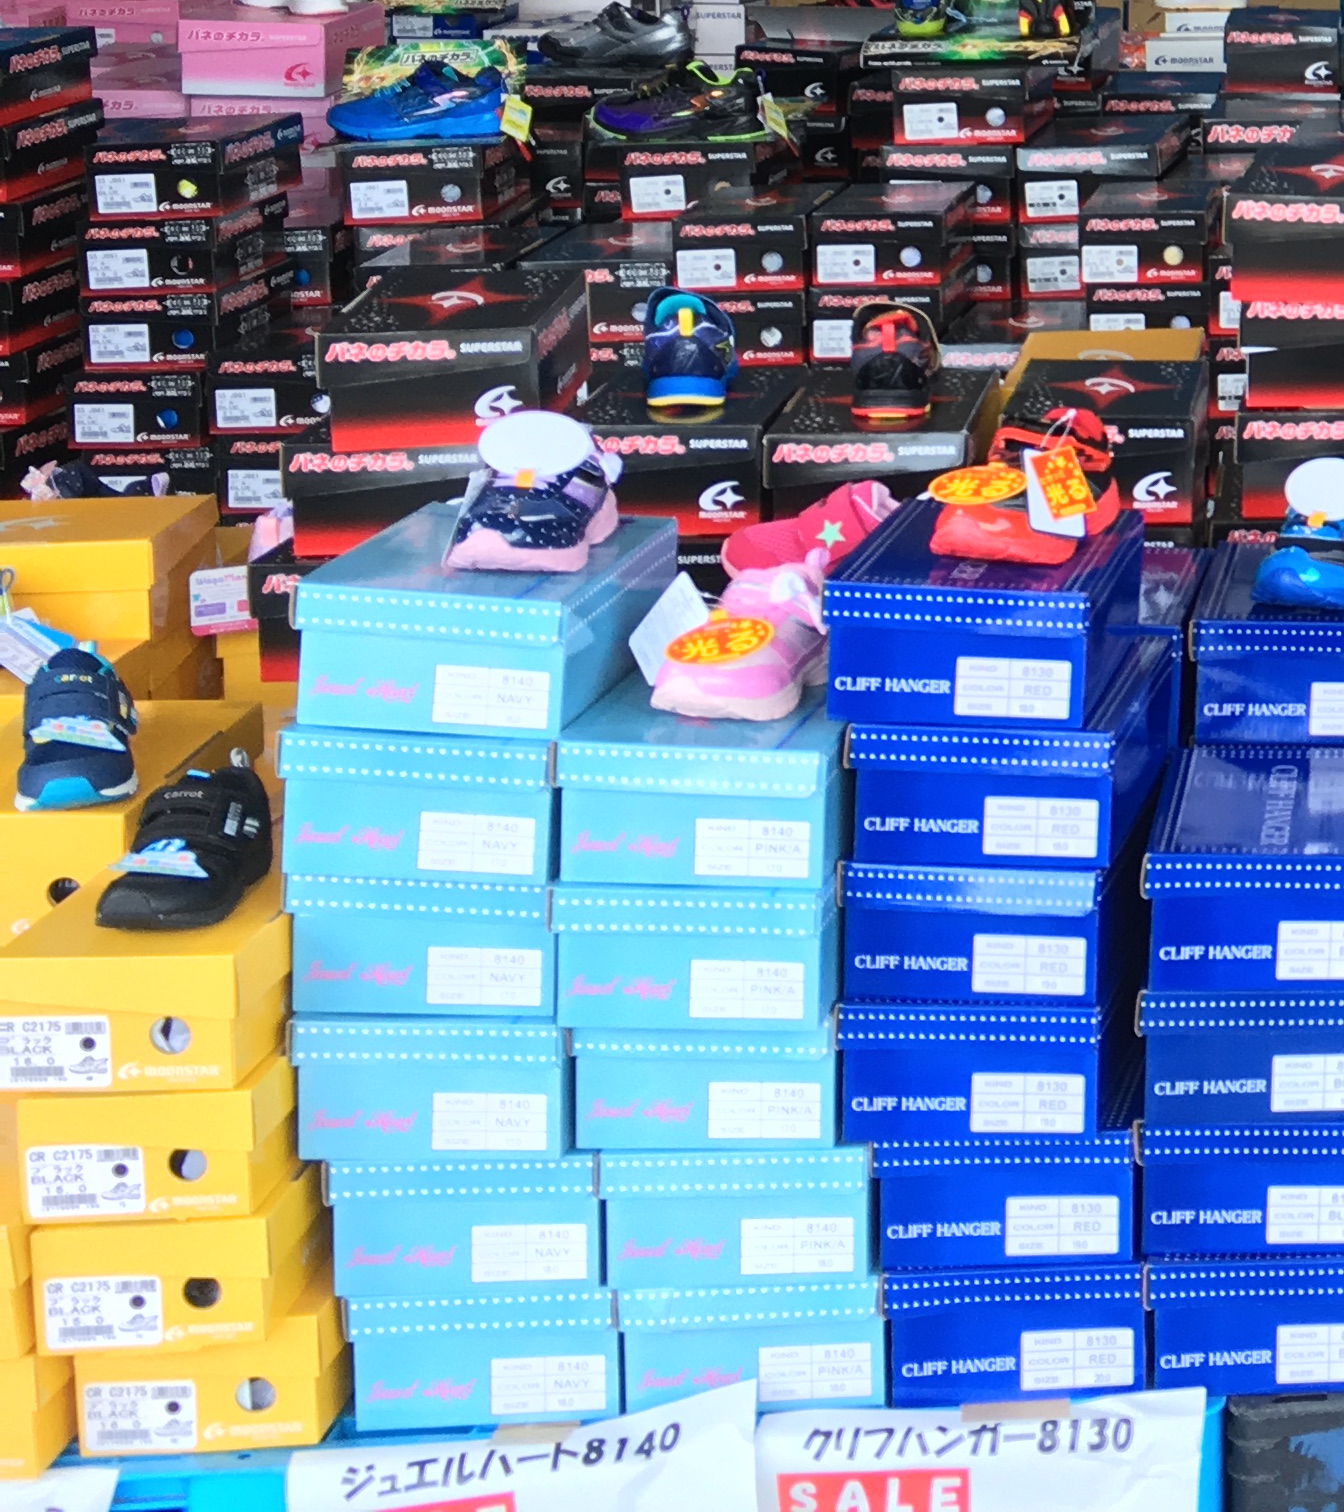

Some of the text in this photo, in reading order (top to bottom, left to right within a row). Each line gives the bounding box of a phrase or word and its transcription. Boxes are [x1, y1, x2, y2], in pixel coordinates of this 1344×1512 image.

[325, 338, 523, 363] バネのチカラ。 SUPERSTAR
[288, 450, 478, 474] バネのチカラ。 SUPERSTAR
[772, 442, 956, 463] バネのチカラ。 SUPERSTAR
[834, 677, 952, 695] CLIFF HANGER
[1203, 701, 1307, 718] CLIFF HANGER
[864, 817, 979, 835] CLIFF HANGER
[1160, 944, 1273, 961] CLIFF HANGER
[903, 1355, 1016, 1379] CLIFF HANGER
[1160, 1350, 1272, 1369] CLIFF HANGER
[802, 1416, 1134, 1461] クリフハンガー8130
[339, 1421, 682, 1500] ジュエルハート8140
[788, 1476, 962, 1512] SALE
